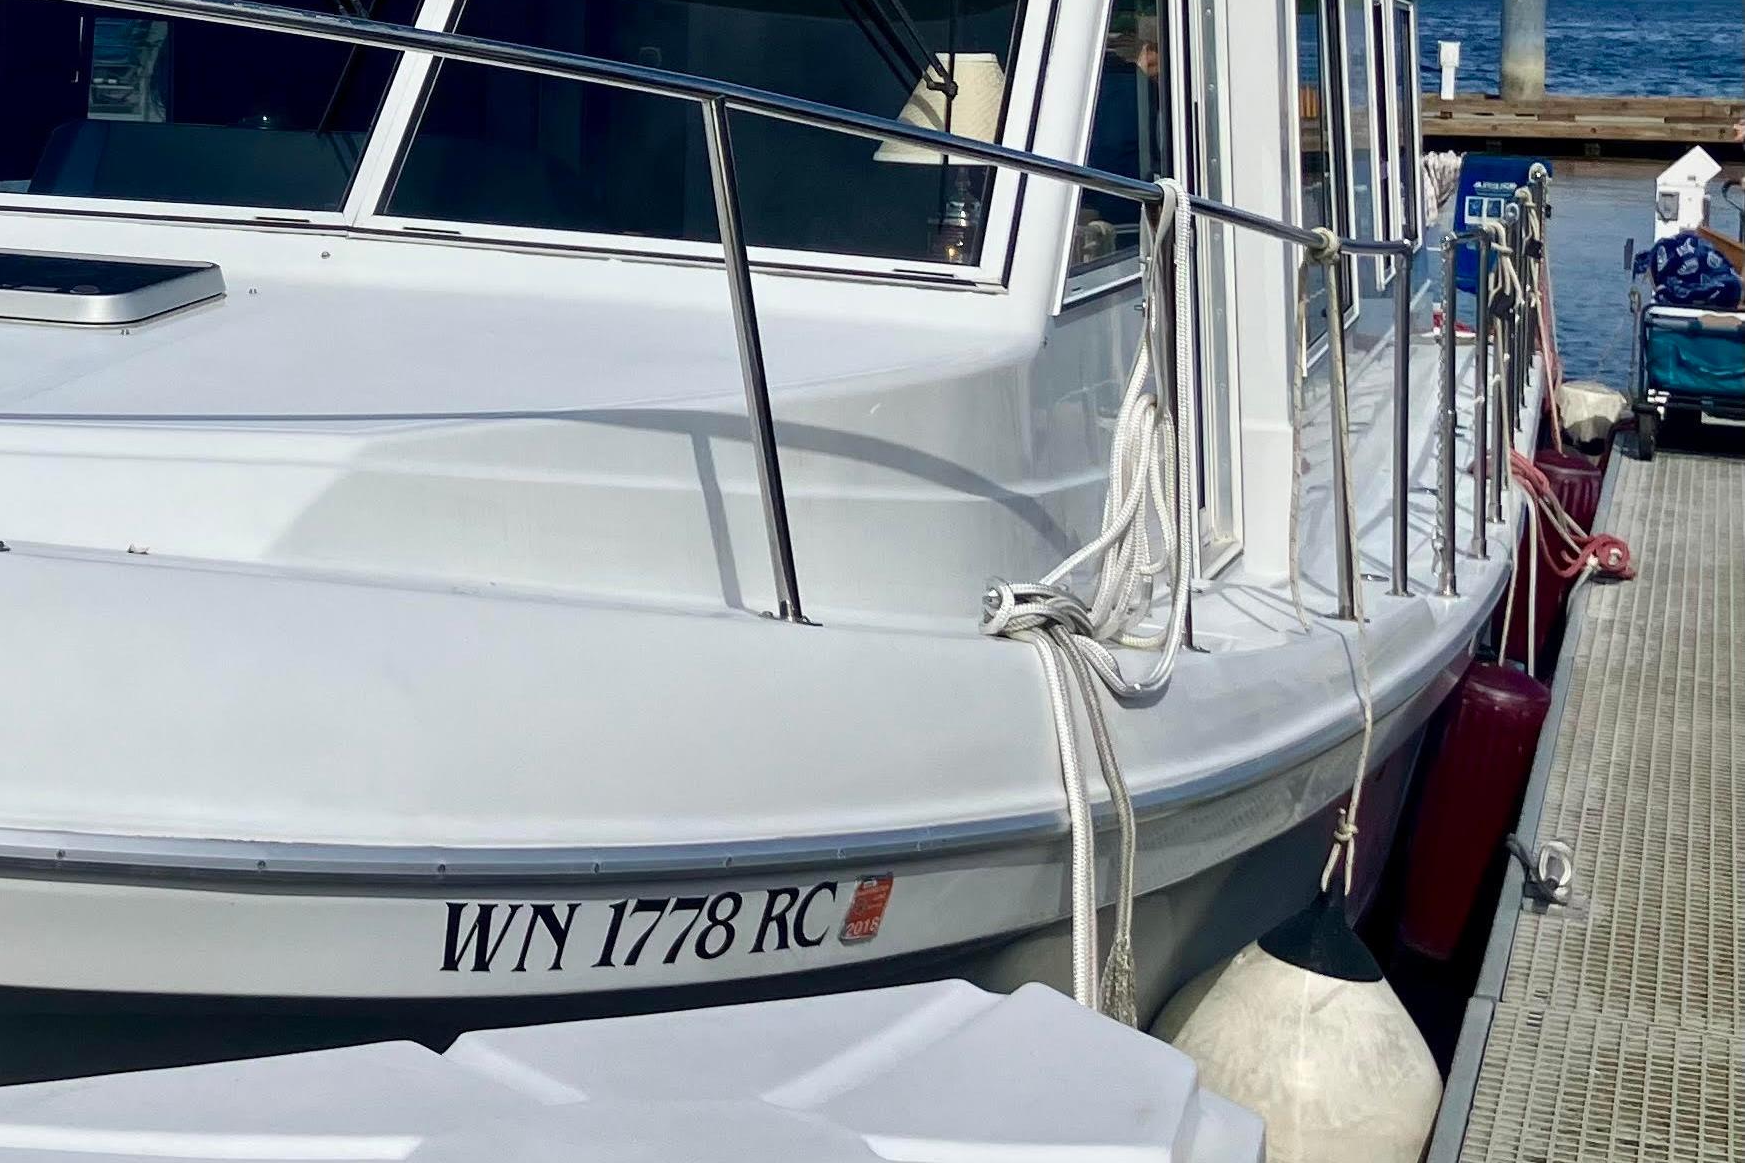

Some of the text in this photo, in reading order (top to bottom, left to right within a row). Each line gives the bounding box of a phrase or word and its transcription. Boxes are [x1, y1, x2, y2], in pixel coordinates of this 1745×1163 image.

[440, 901, 582, 972] WN
[591, 891, 743, 968] 1778
[748, 881, 839, 954] RC
